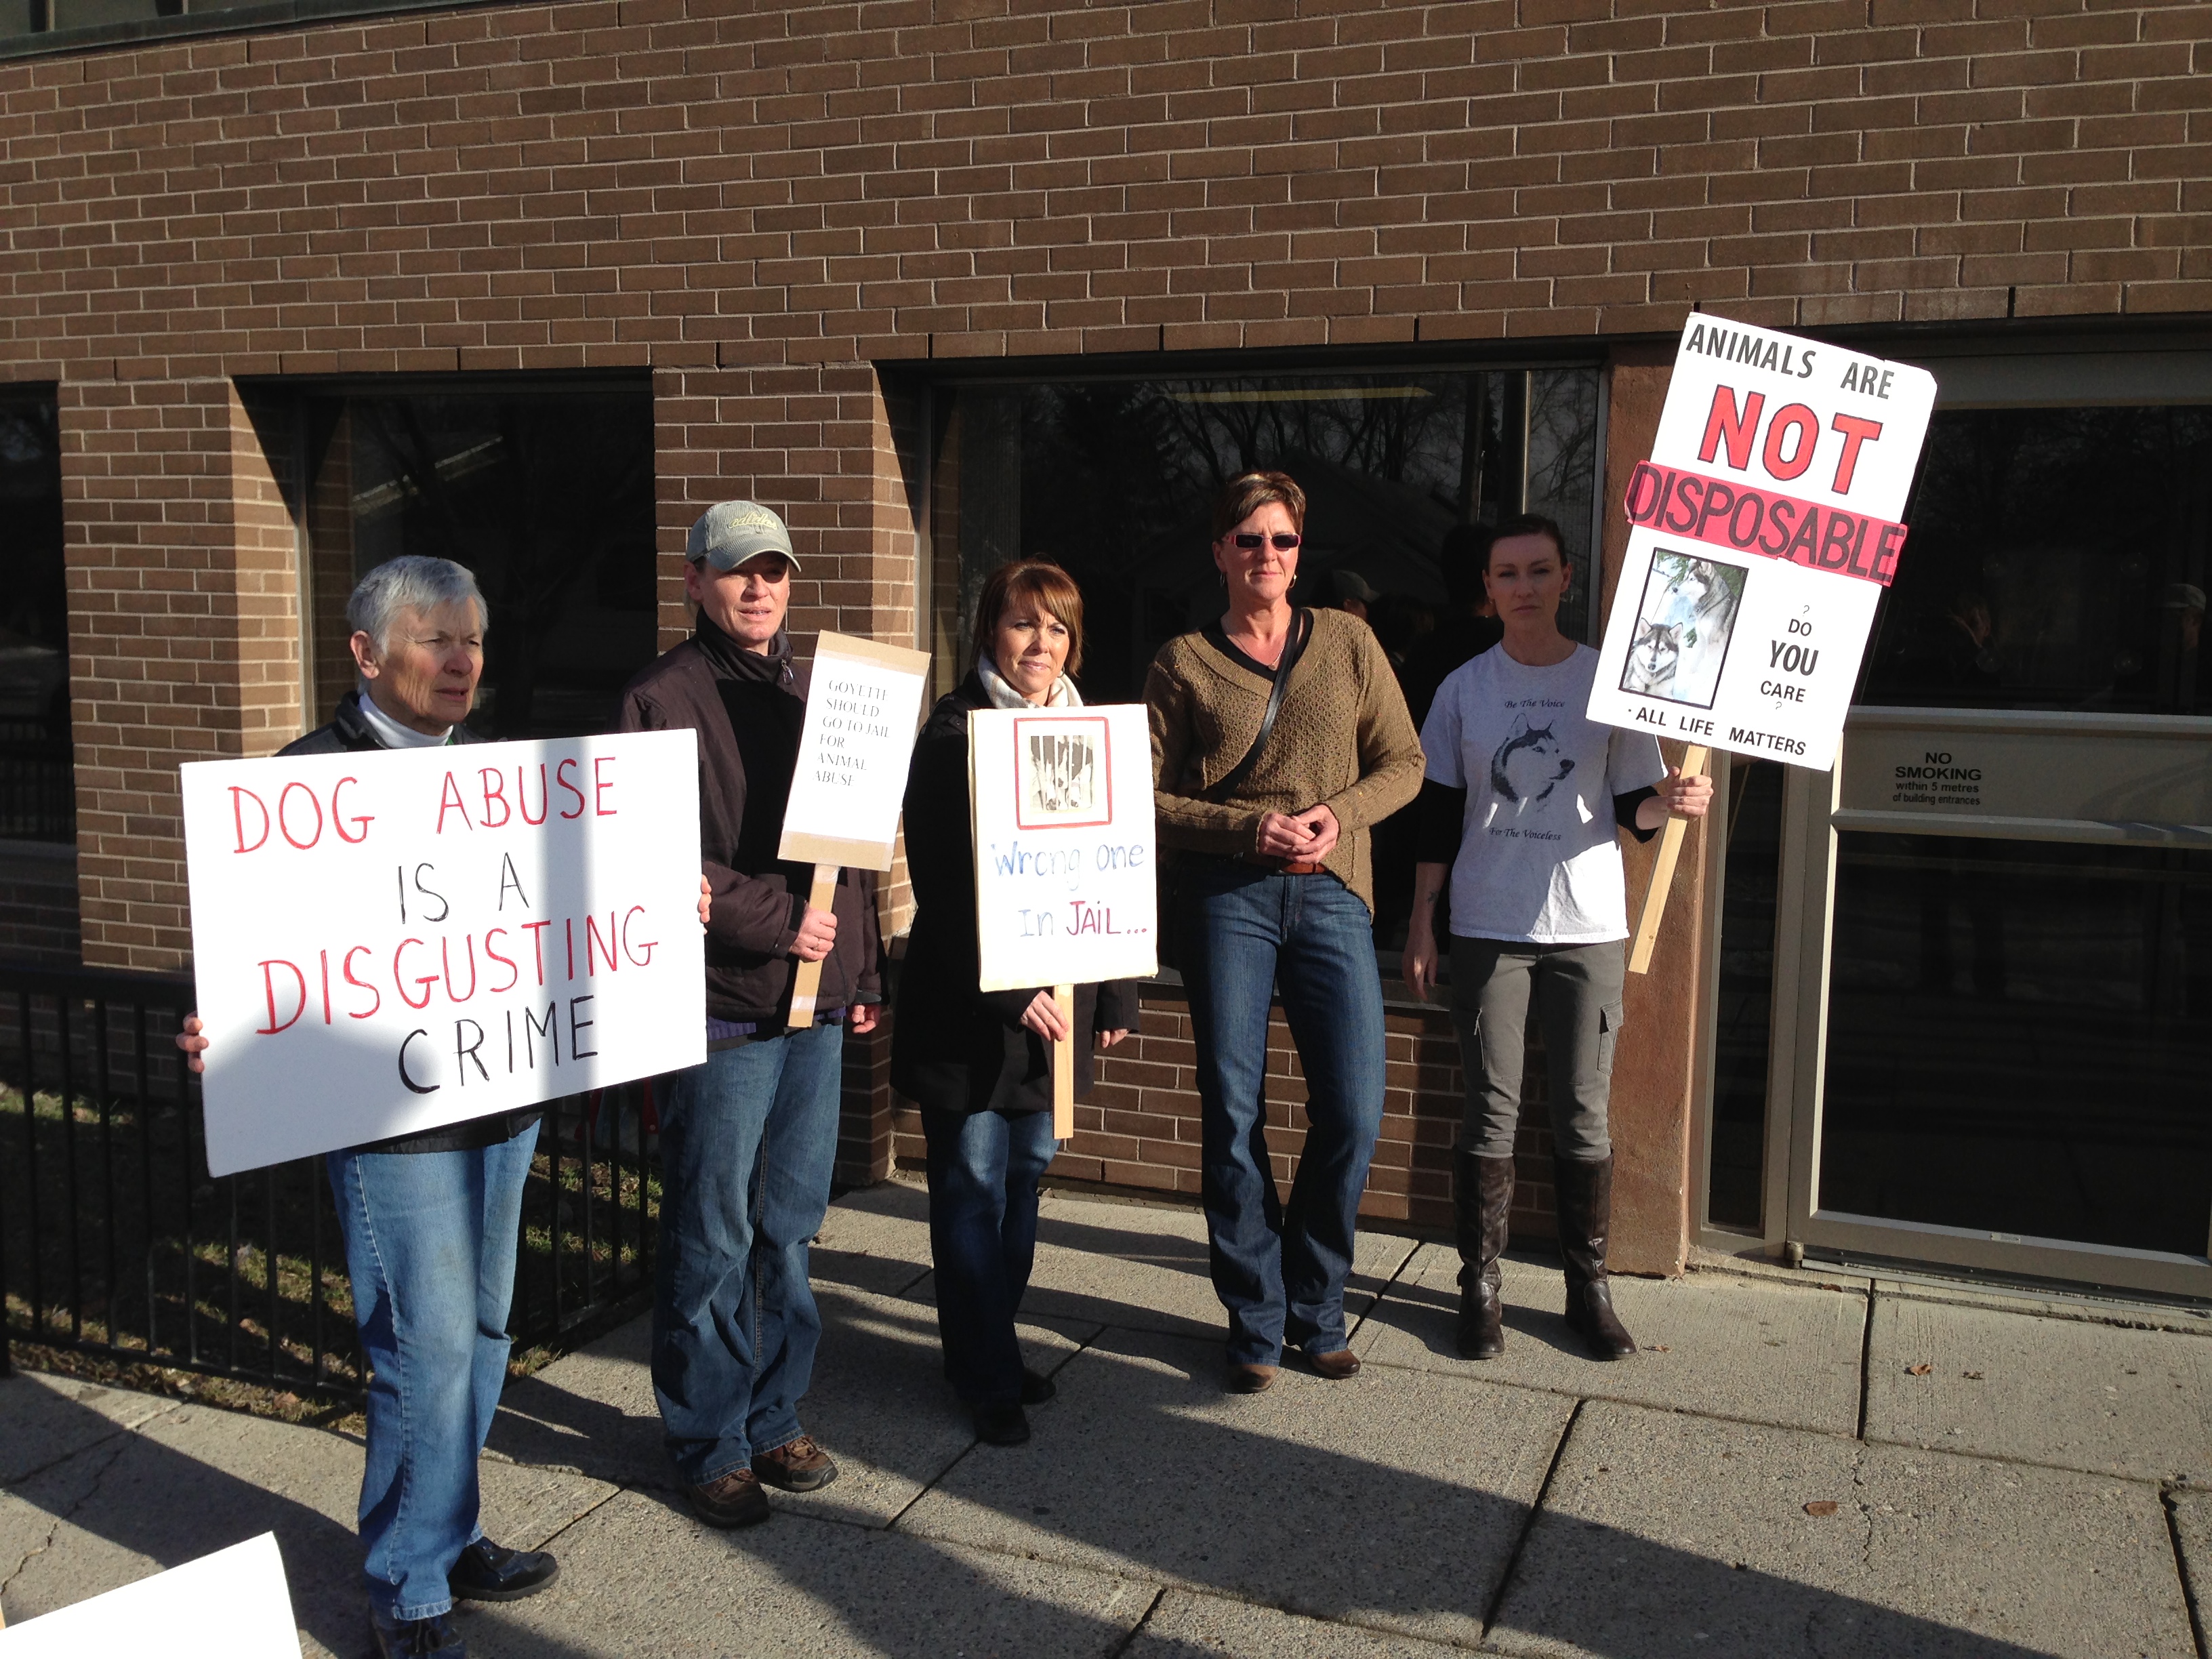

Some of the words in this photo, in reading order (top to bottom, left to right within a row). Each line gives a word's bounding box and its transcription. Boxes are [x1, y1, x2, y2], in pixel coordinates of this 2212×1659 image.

[1686, 323, 1816, 378] ANIMALS
[1840, 361, 1895, 400] ARE
[1697, 384, 1884, 495] NOT
[1626, 464, 1906, 581] DISPOSABLE
[1788, 618, 1813, 637] DO
[1770, 640, 1820, 676] YOU
[1760, 680, 1807, 703] CARE
[826, 697, 880, 717] SHOULD
[1504, 700, 1517, 708] Be
[1519, 698, 1537, 708] The
[1539, 698, 1565, 708] Voice
[823, 716, 842, 729] GO
[846, 720, 863, 733] TO
[865, 723, 890, 738] JAIL
[1679, 716, 1715, 737] LIFE
[1728, 728, 1807, 756] MATTERS
[820, 733, 845, 749] FOR
[817, 752, 867, 770] ANIMAL
[1925, 752, 1952, 764] NO
[813, 770, 854, 787] ABUSE
[1895, 766, 1982, 781] SMOKING
[1896, 781, 1928, 791] within
[1931, 782, 1938, 792] 5
[1941, 783, 1979, 793] metres
[228, 777, 375, 853] DOG
[436, 756, 617, 834] ABUSE
[1893, 793, 1901, 802] of
[1903, 793, 1936, 806] building
[1938, 796, 1980, 805] entrances
[1490, 827, 1502, 835] For
[1504, 827, 1520, 838] The
[1522, 829, 1561, 840] Voiceless
[991, 841, 1080, 891] Wrong
[397, 863, 449, 924] IS
[498, 852, 530, 911] A
[1018, 909, 1054, 937] In
[255, 905, 659, 1034] DISGUSTING
[398, 995, 598, 1094] CRIME
